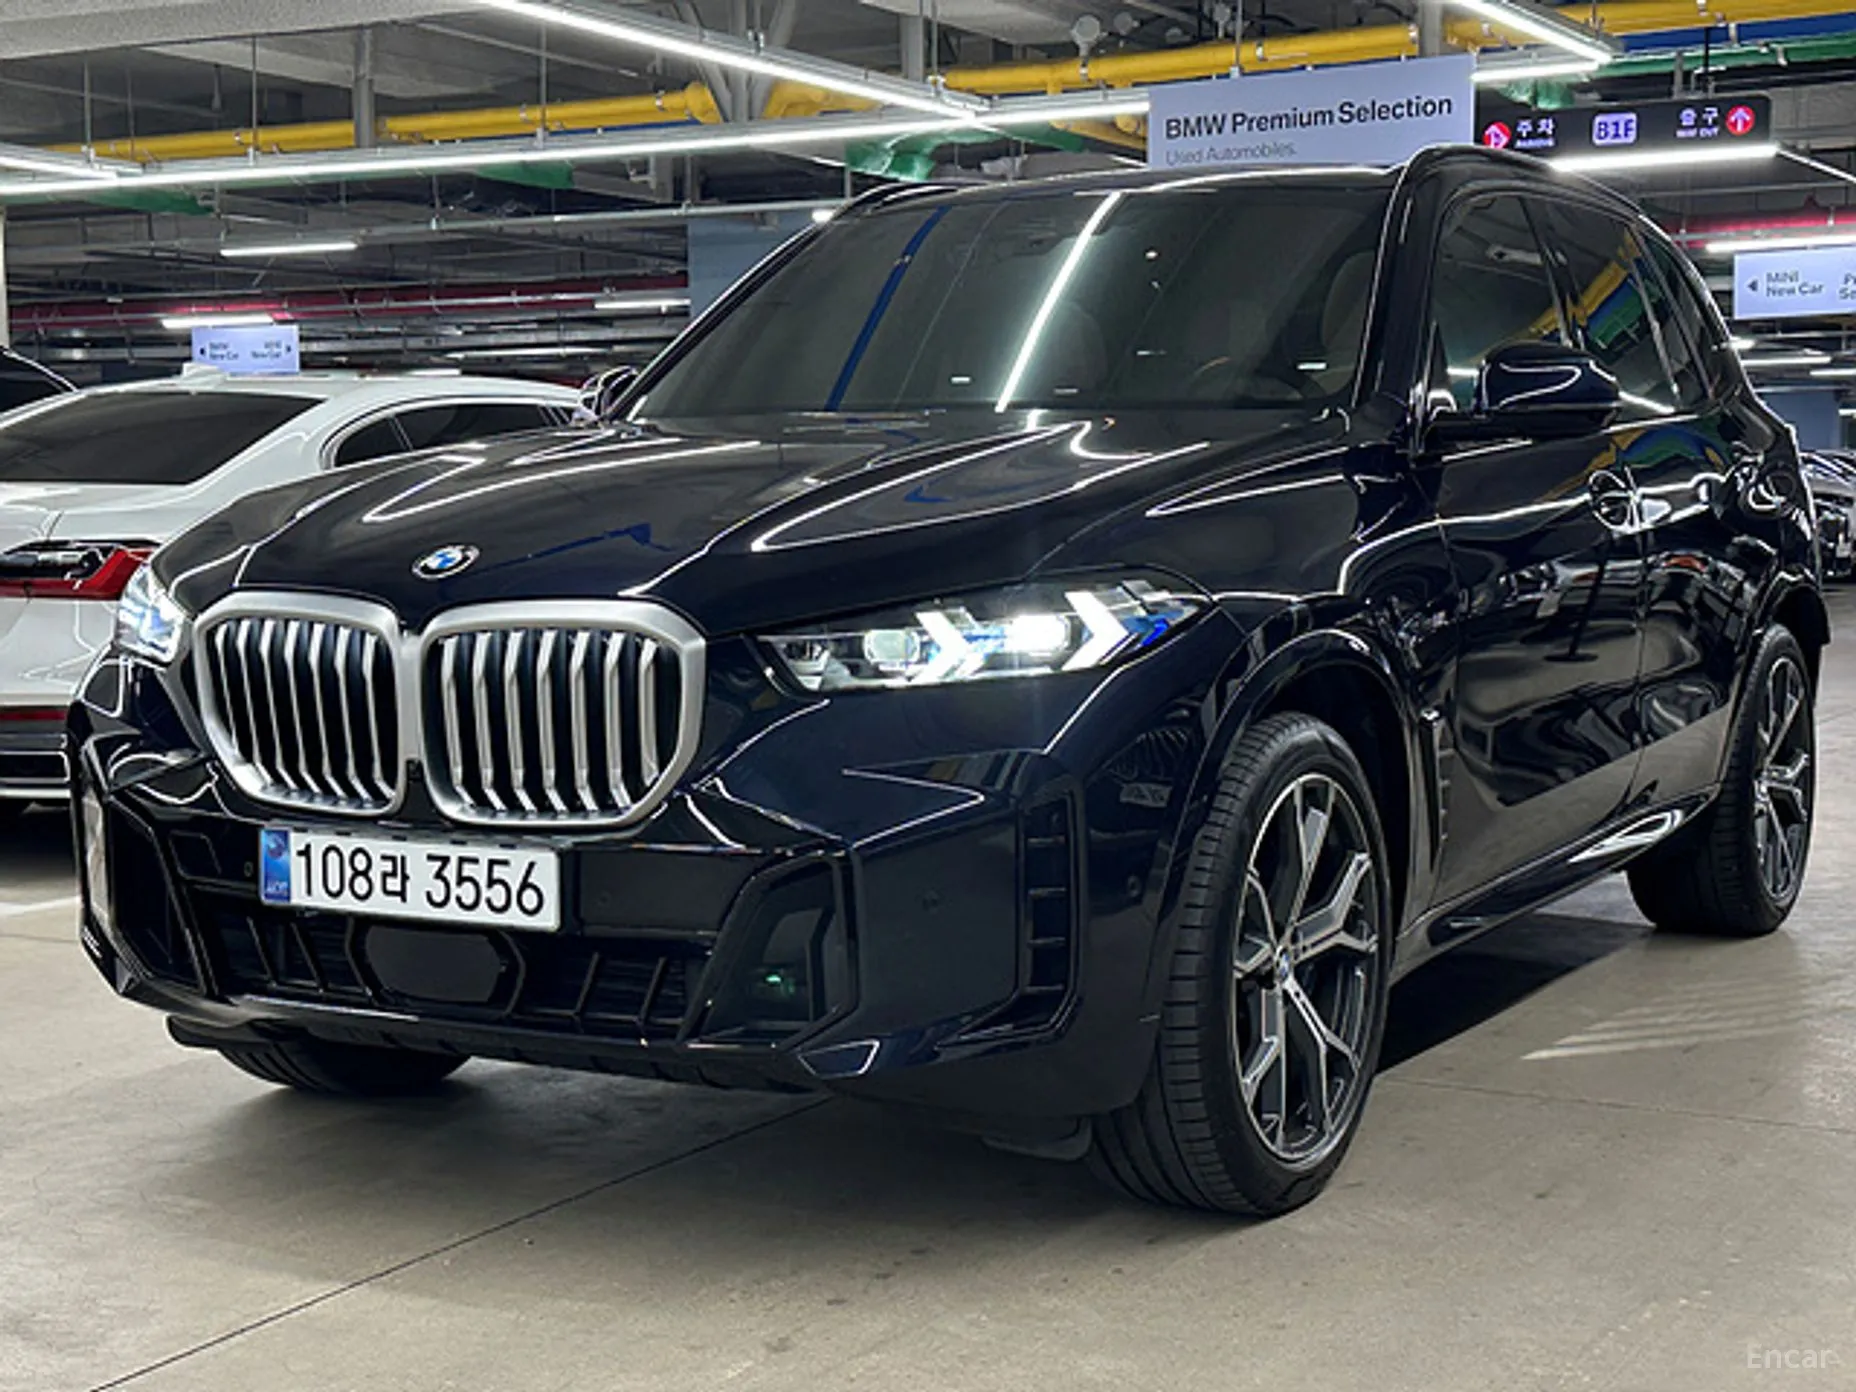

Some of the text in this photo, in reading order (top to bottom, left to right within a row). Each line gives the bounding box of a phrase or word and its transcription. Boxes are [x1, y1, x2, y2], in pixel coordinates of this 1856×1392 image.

[1165, 96, 1452, 140] BMW Premium Selection
[1166, 149, 1203, 166] Used
[1766, 281, 1824, 298] New Car
[296, 843, 544, 917] 108라 3556
